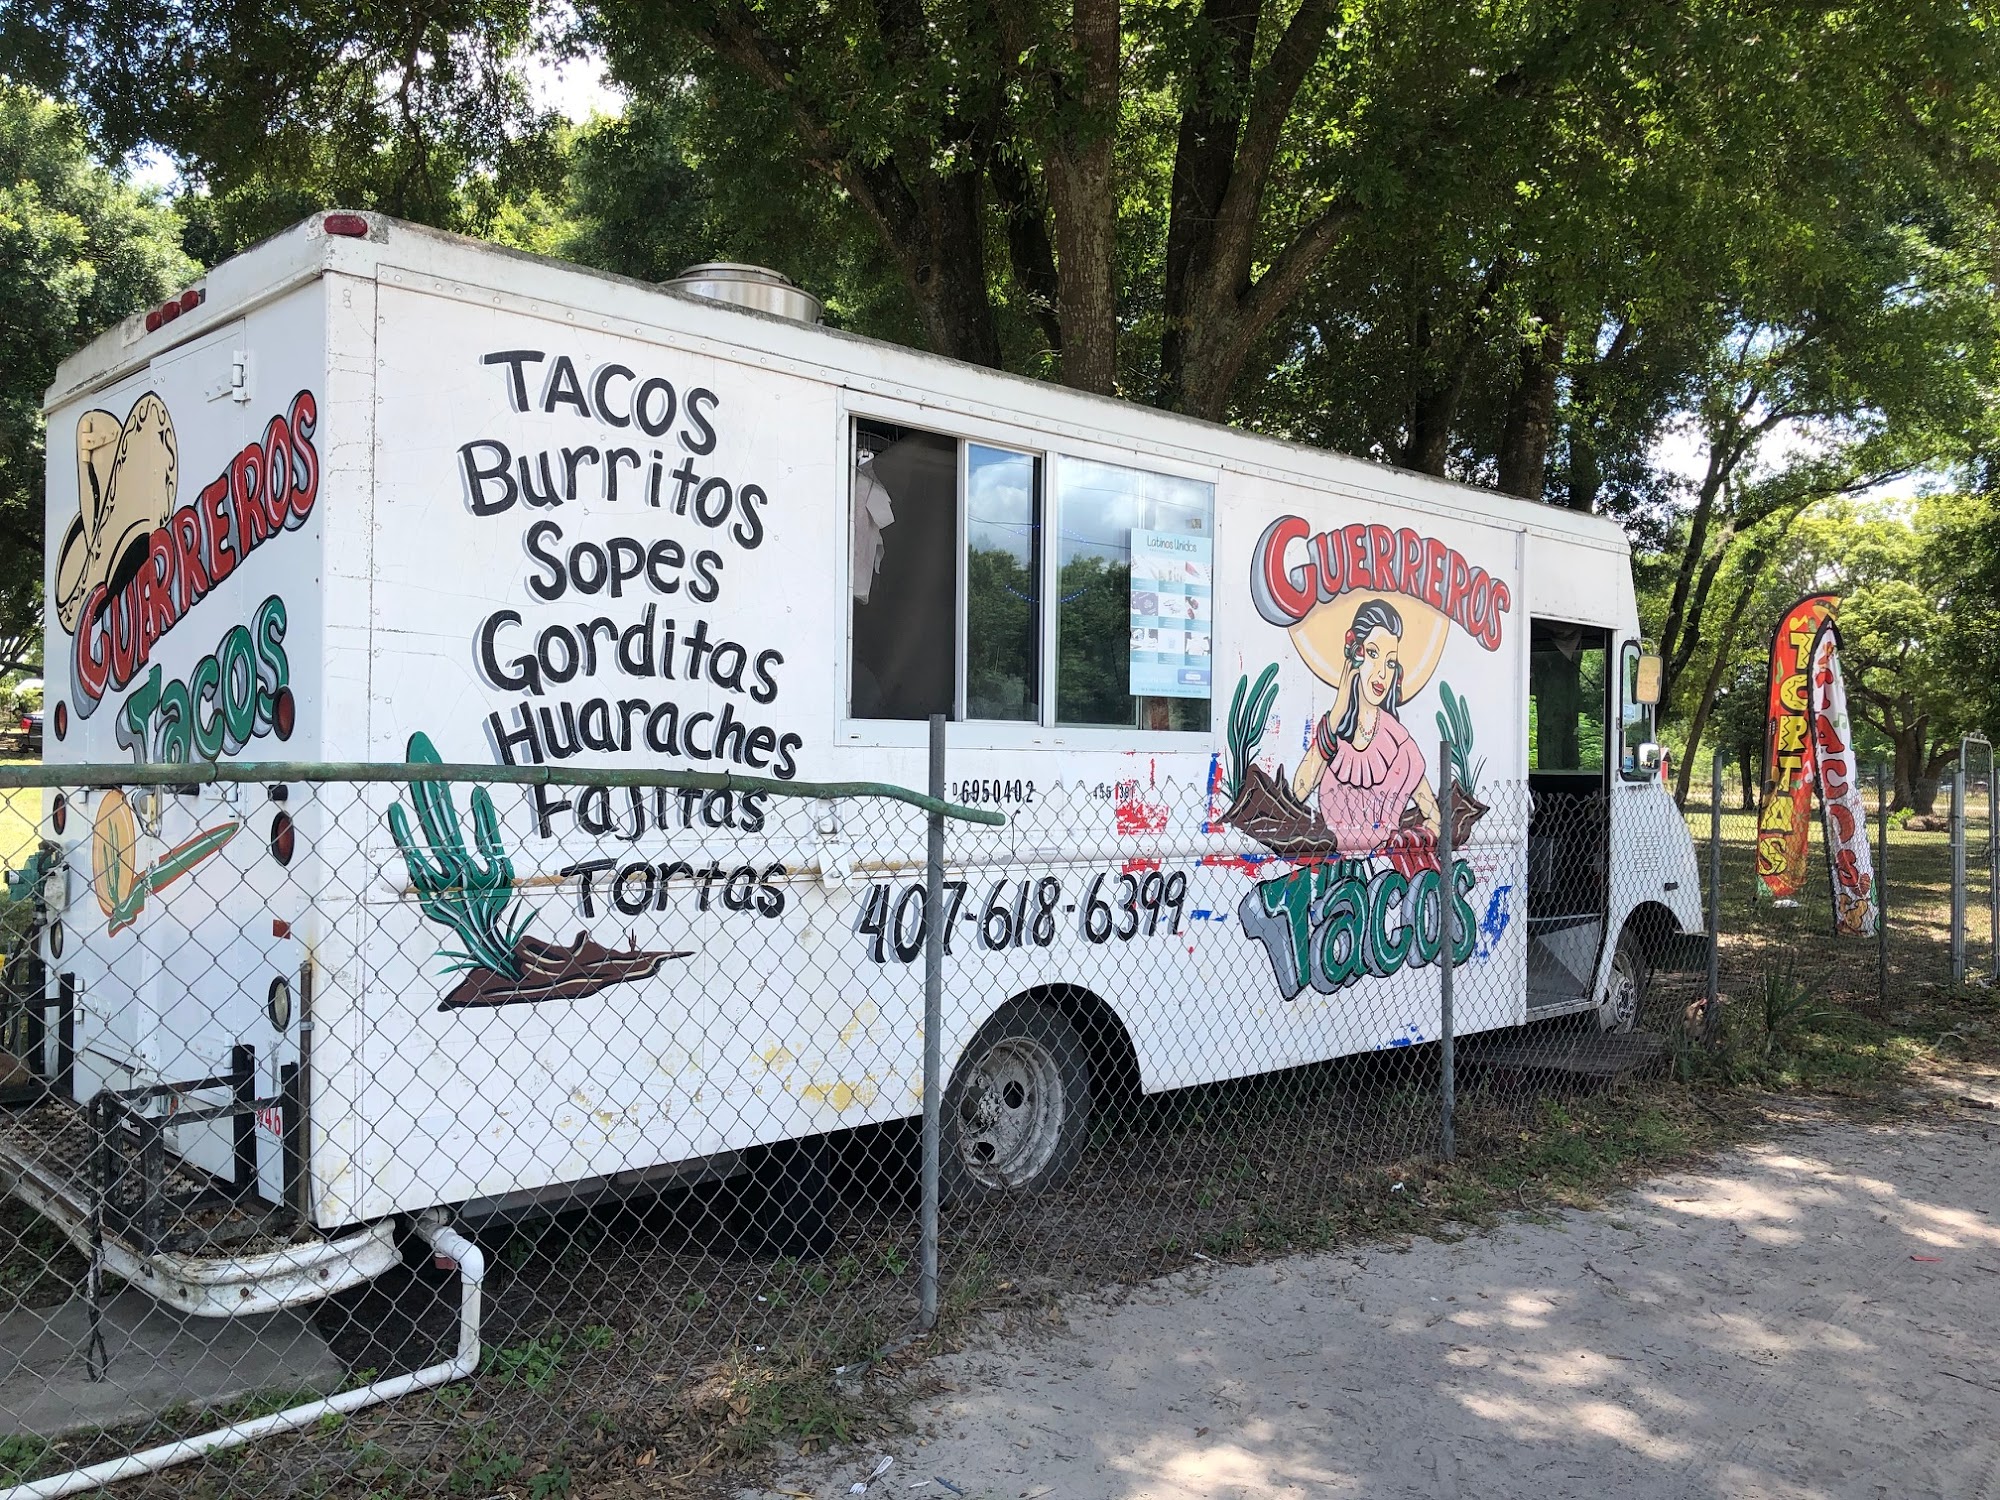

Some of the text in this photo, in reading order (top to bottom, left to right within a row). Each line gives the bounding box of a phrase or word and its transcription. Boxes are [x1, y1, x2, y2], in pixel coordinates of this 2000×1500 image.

[479, 350, 719, 456] TACOS
[456, 439, 769, 551] Burritos
[1147, 535, 1174, 550] Latinos
[1174, 538, 1198, 553] Unidos
[70, 389, 320, 720] GUERREROS
[523, 519, 724, 604] Sopes
[1250, 514, 1511, 652] GUERREROS
[472, 602, 785, 705] Gorditas
[482, 698, 803, 780] Huaraches
[1758, 631, 1815, 876] TORTAS
[962, 779, 1033, 804] 6950402
[555, 857, 787, 919] Tortas
[852, 870, 1188, 964] 407-618-6399
